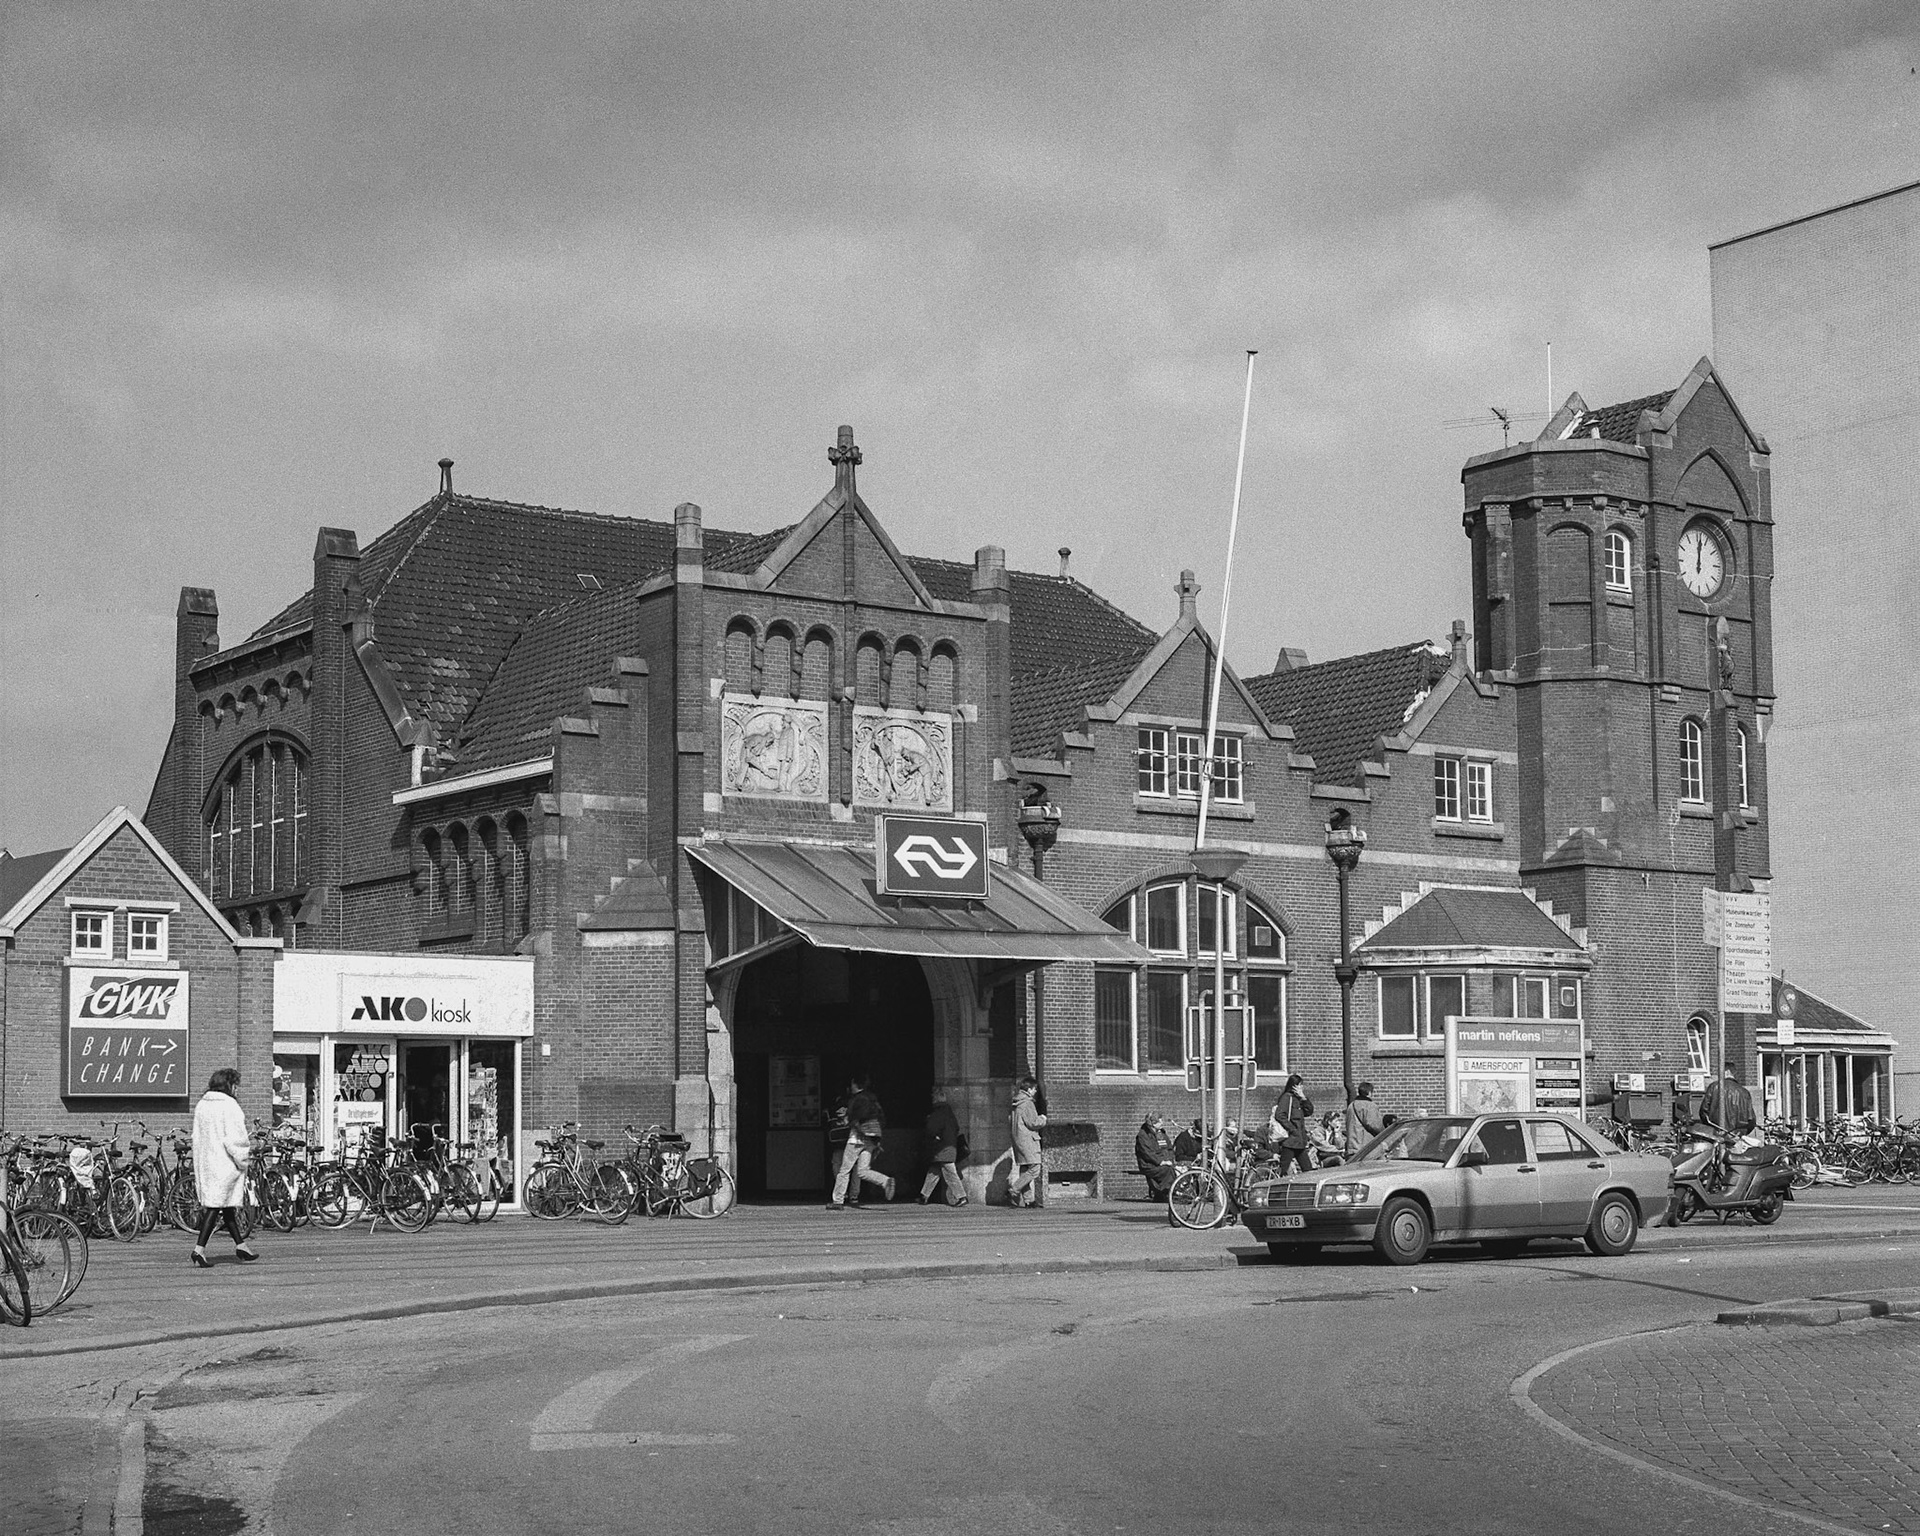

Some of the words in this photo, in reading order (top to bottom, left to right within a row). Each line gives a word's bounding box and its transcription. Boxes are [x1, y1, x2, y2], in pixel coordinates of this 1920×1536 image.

[1735, 921, 1755, 929] Zonnehof
[89, 982, 177, 1016] GWK
[351, 996, 427, 1022] AKO
[431, 998, 471, 1023] kiosk
[1459, 1030, 1495, 1041] martin
[1499, 1030, 1541, 1042] nefkens
[82, 1036, 150, 1056] BANK
[80, 1062, 175, 1083] CHANGE
[346, 1059, 388, 1074] AKO
[1471, 1061, 1523, 1071] AMERSFOORT
[340, 1074, 382, 1088] AKO
[334, 1088, 375, 1102] AKO
